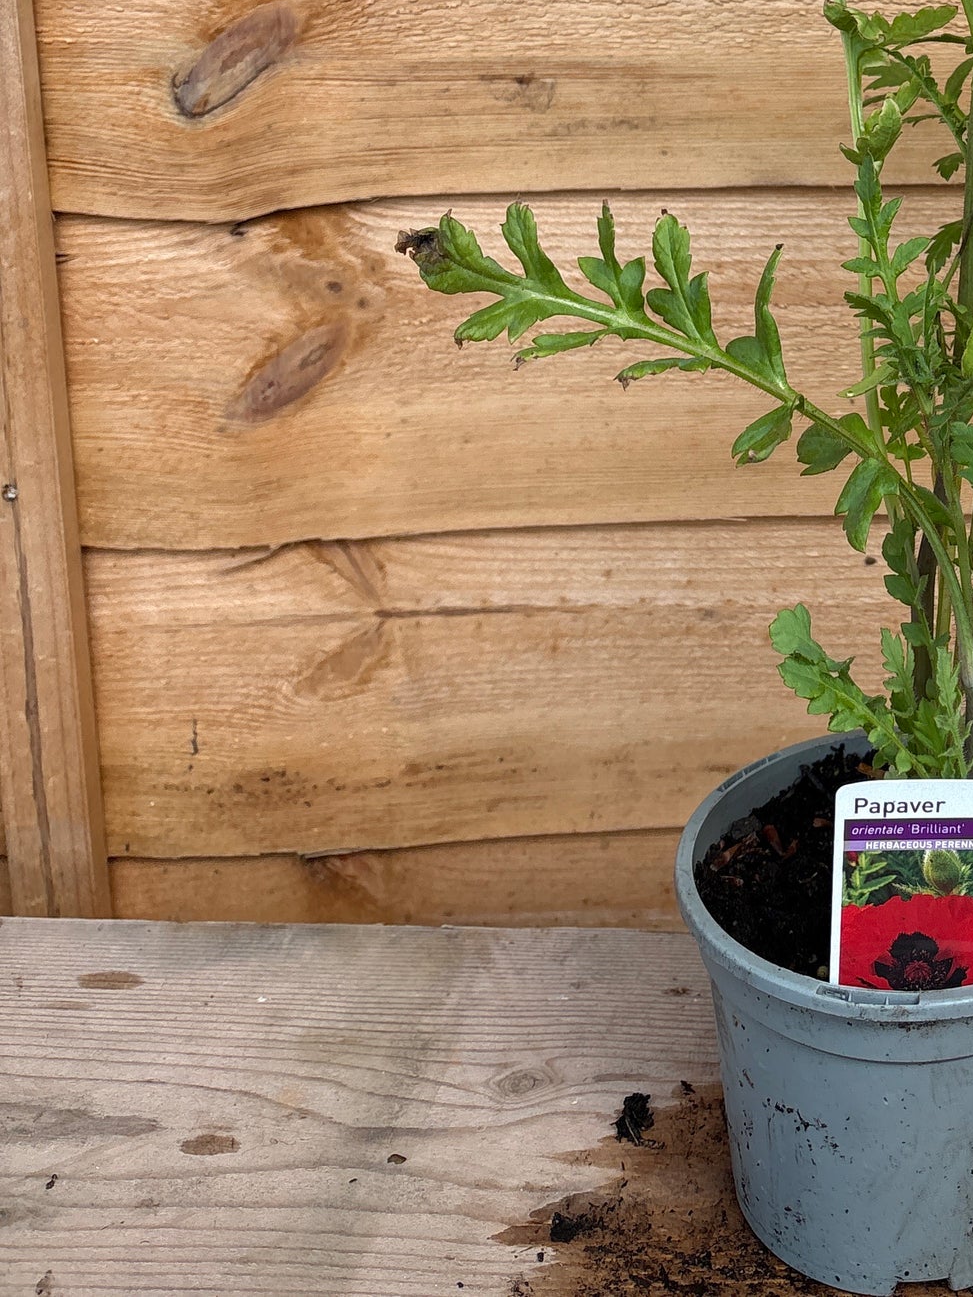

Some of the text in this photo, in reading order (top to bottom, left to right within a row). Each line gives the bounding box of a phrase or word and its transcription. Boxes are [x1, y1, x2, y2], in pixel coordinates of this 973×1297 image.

[854, 798, 946, 817] Papaver
[851, 824, 904, 835] orientale
[865, 840, 932, 850] HERBACEOUS
